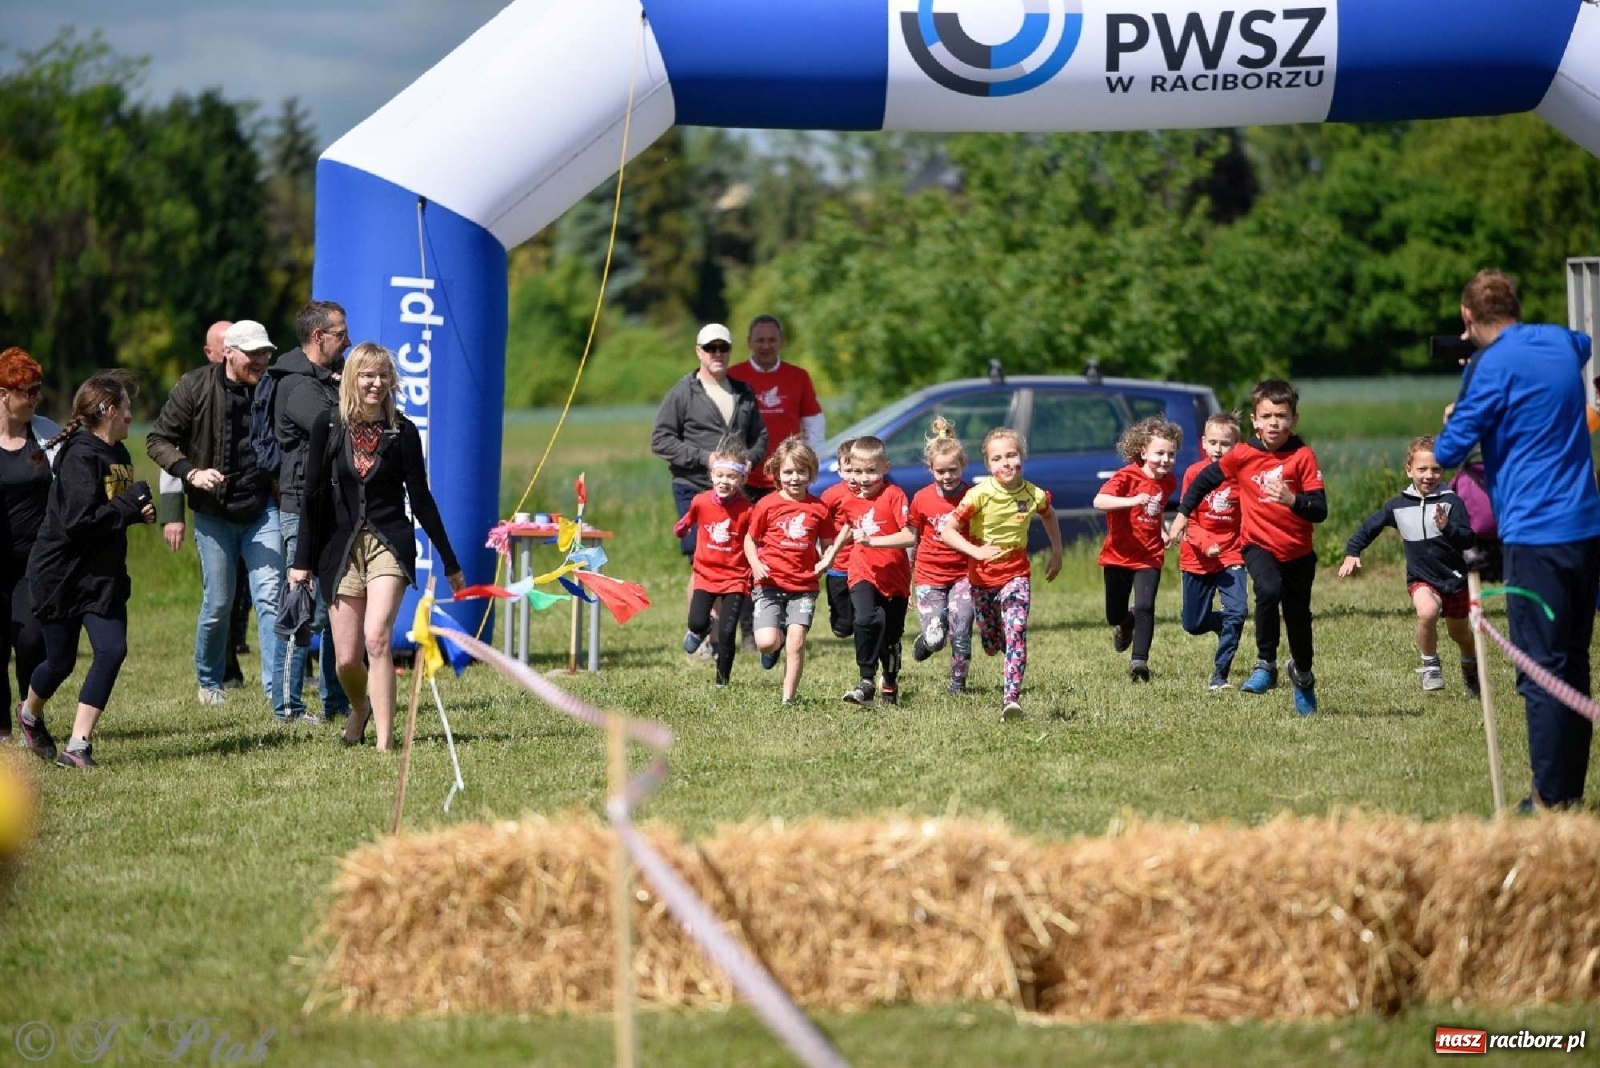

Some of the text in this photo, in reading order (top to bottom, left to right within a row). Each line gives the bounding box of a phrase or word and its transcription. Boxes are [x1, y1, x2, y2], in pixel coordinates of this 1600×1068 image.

[1105, 7, 1327, 72] PWSZ
[1106, 70, 1325, 94] W RACIBORZU
